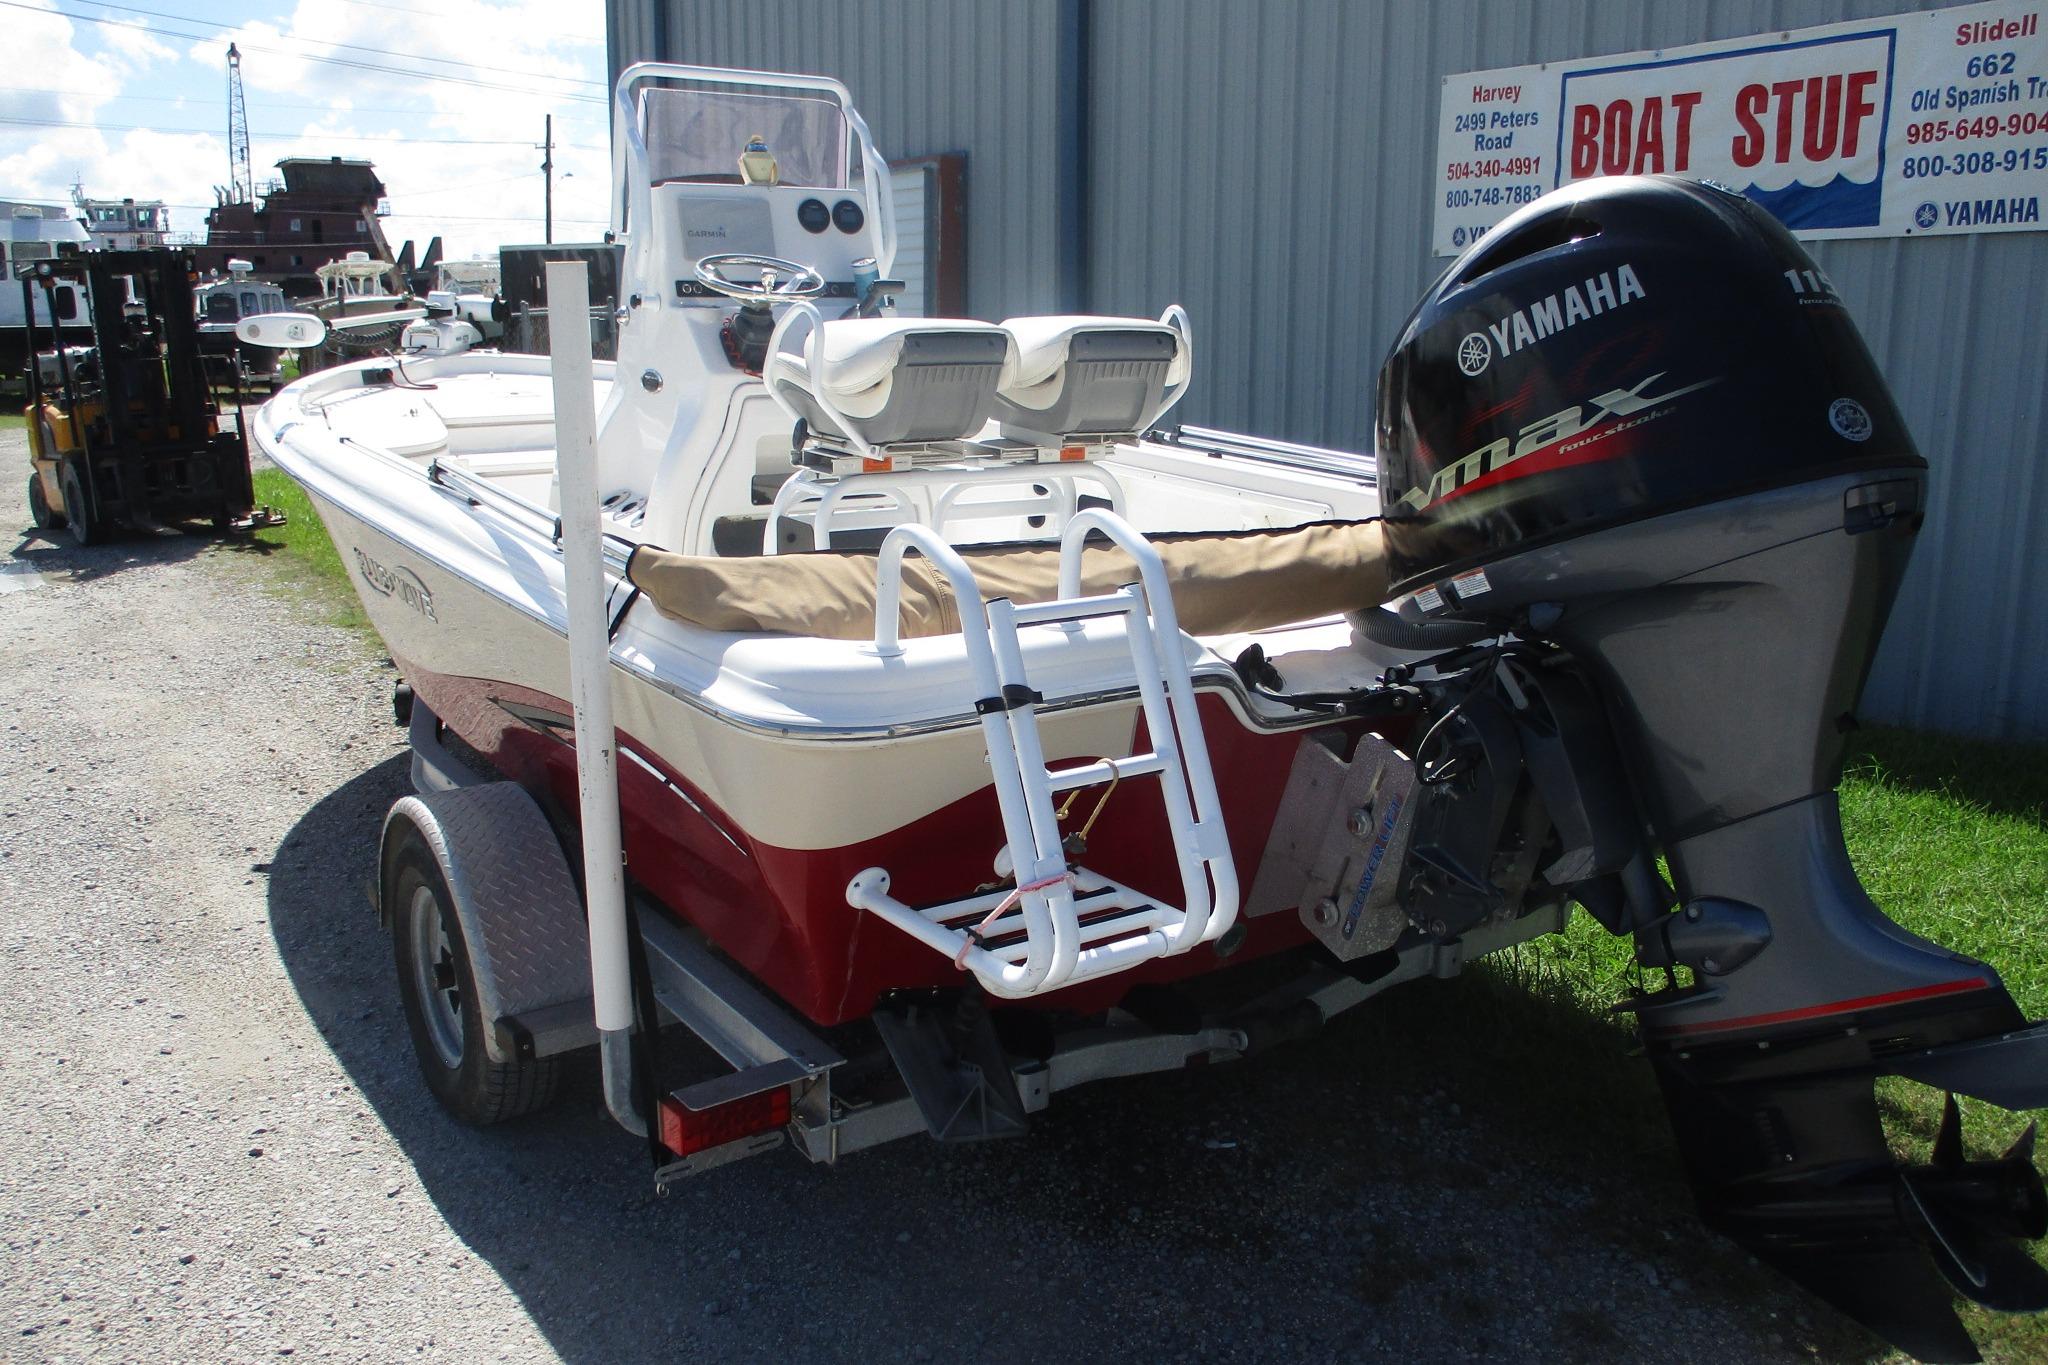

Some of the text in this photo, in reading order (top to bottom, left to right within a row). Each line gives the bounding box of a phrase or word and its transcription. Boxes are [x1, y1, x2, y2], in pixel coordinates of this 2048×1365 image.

[1955, 13, 2038, 46] Slidell
[1966, 52, 2016, 79] 662
[1472, 85, 1521, 104] Harvey
[1911, 76, 2048, 113] Old Spanish Tr
[1455, 111, 1539, 133] 2499 Peters
[1571, 70, 1878, 179] BOAT STUF
[1474, 132, 1513, 151] Road
[1447, 156, 1541, 181] 504-340-4991
[1446, 185, 1541, 208] 800-748-7883
[1944, 197, 2039, 226] YAMAHA
[687, 230, 726, 239] GARMIN
[1488, 263, 1646, 358] YAMAHA
